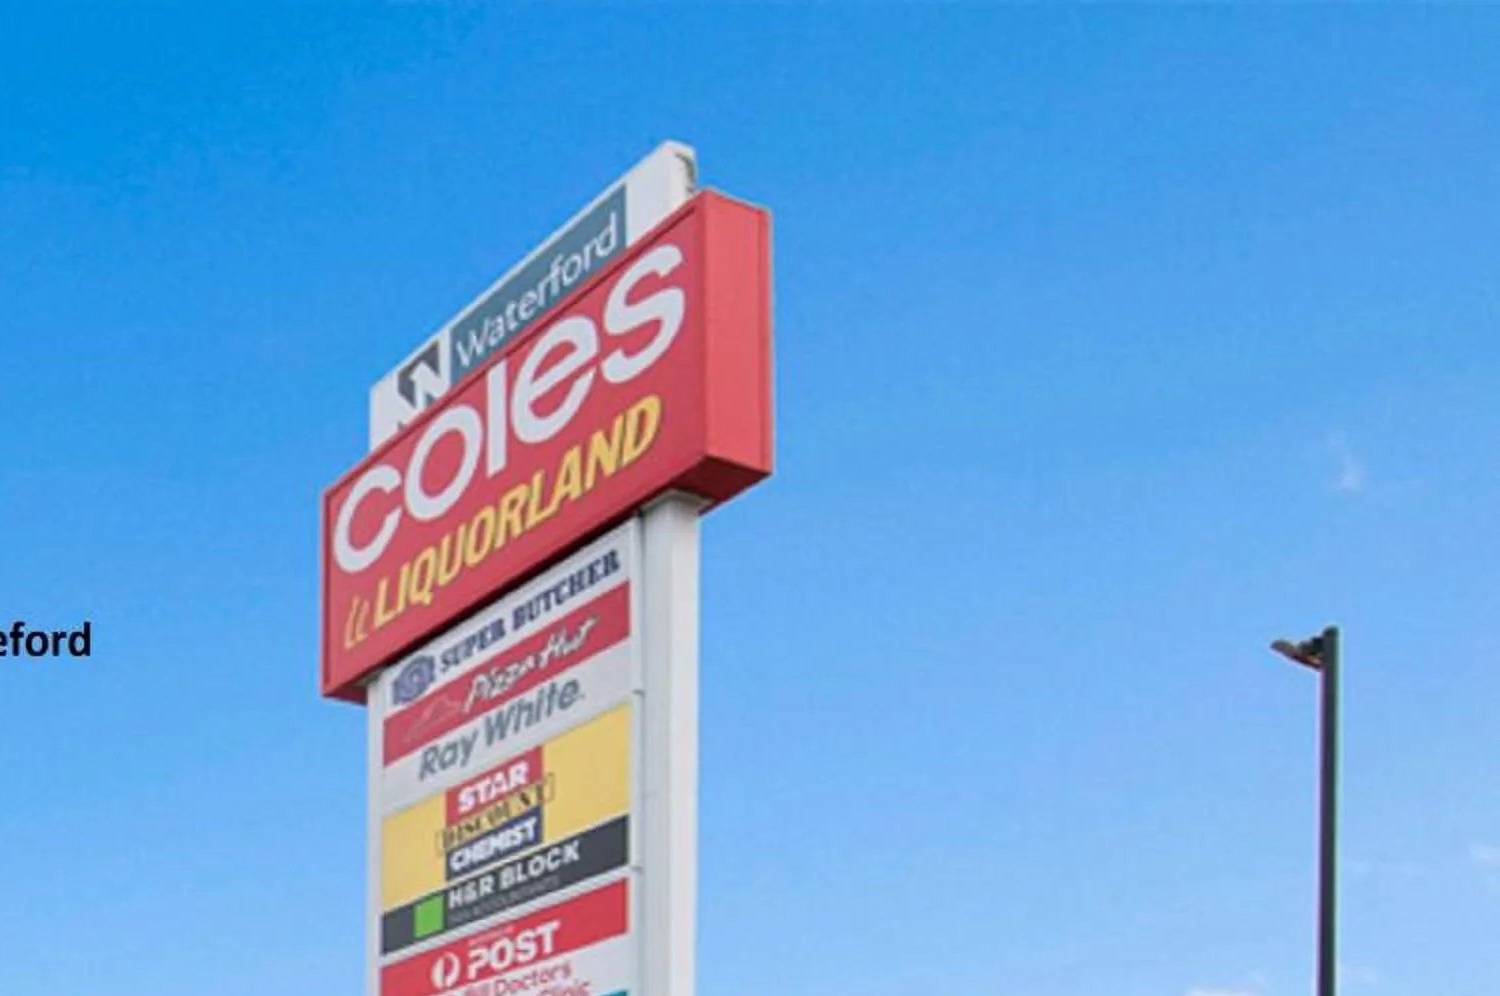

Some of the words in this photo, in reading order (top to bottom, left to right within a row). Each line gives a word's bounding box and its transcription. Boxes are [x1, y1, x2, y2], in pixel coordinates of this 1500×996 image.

[456, 212, 616, 368] Waterford
[333, 244, 685, 573] coles
[373, 395, 661, 630] LIQUORLAND
[440, 617, 506, 672] SUPER
[511, 549, 621, 631] BUTCHER
[418, 729, 477, 781] Ray
[483, 678, 580, 747] White
[457, 761, 529, 814] STAR
[500, 839, 581, 891] BLOCK
[466, 920, 561, 980] POST
